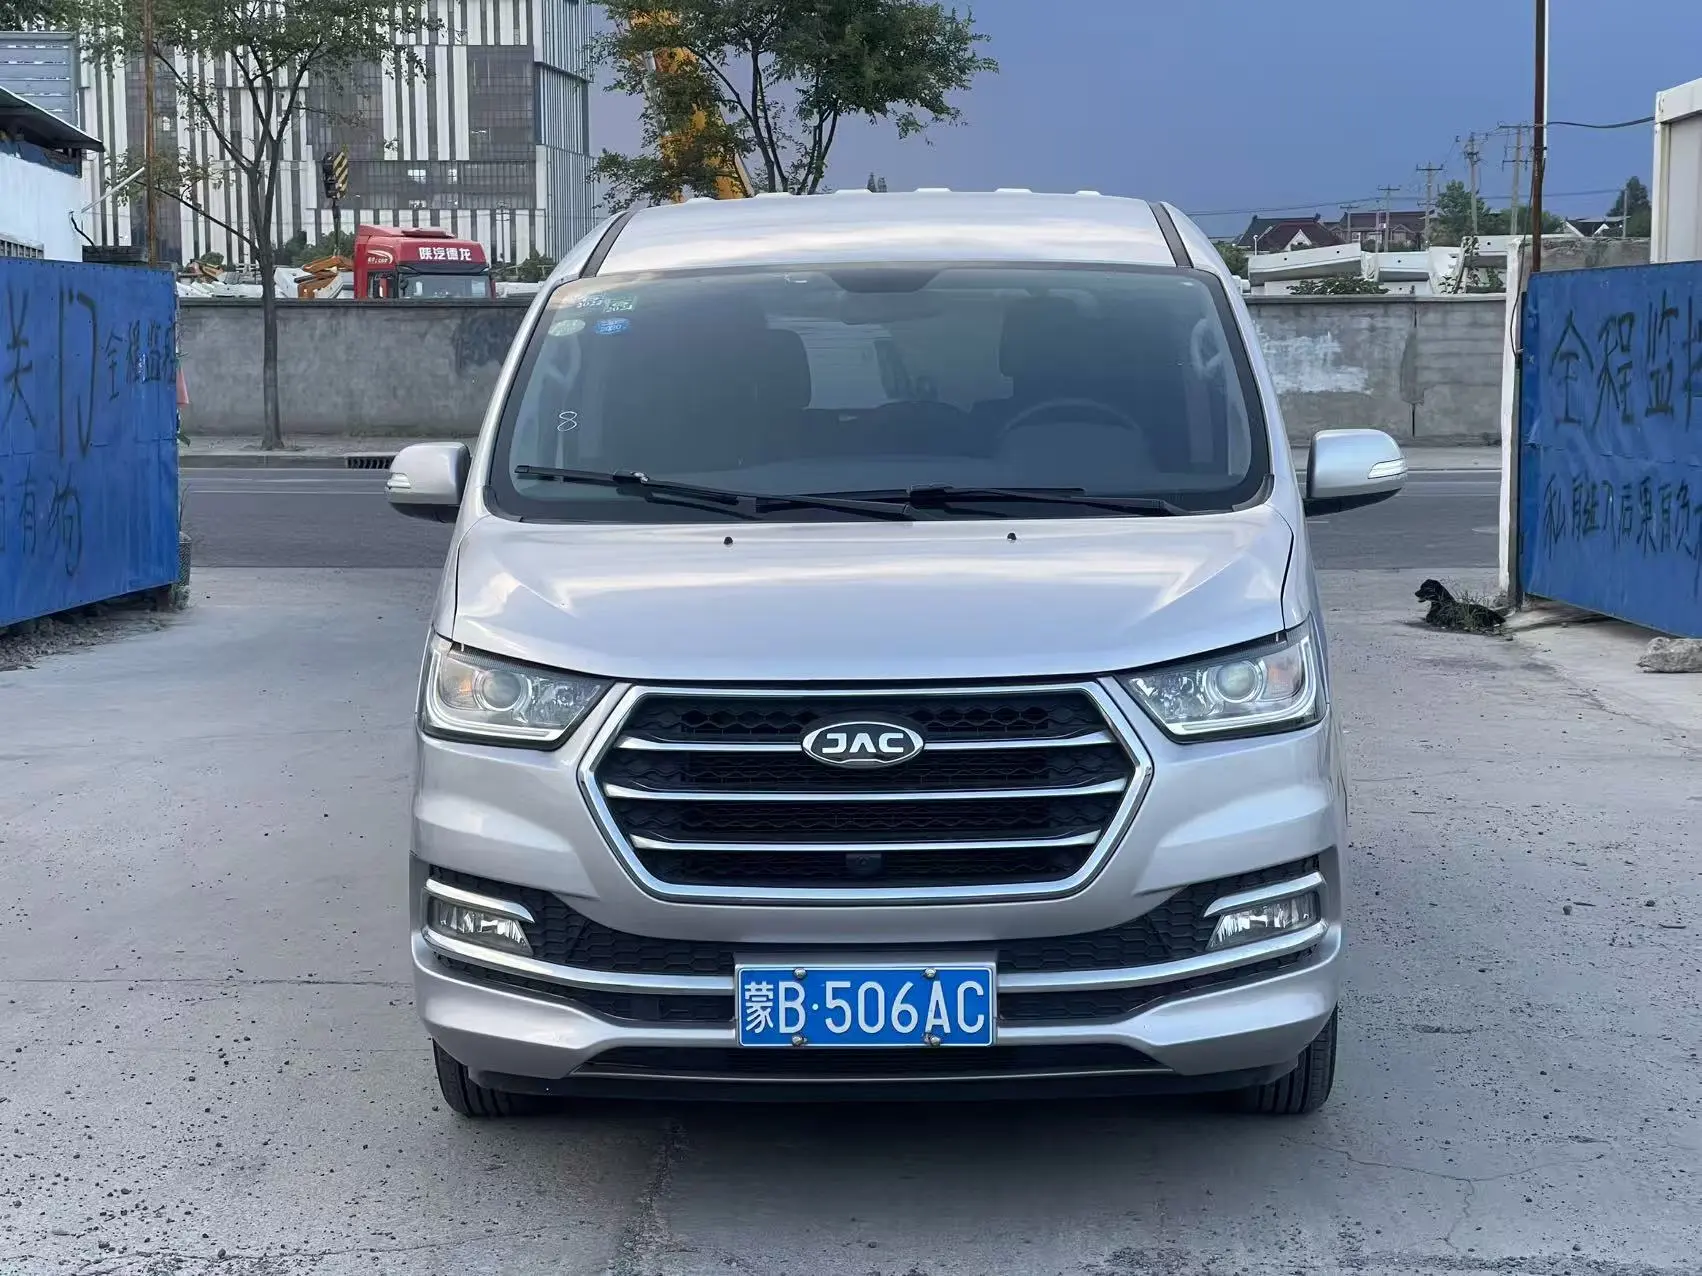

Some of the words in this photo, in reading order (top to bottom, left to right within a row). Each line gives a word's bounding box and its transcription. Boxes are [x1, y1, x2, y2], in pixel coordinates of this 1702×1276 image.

[418, 247, 472, 261] 陕汽德龙
[557, 410, 578, 431] 8
[0, 460, 82, 577] 有狗
[822, 733, 904, 753] JAC
[745, 981, 985, 1034] 蒙B·506AC
